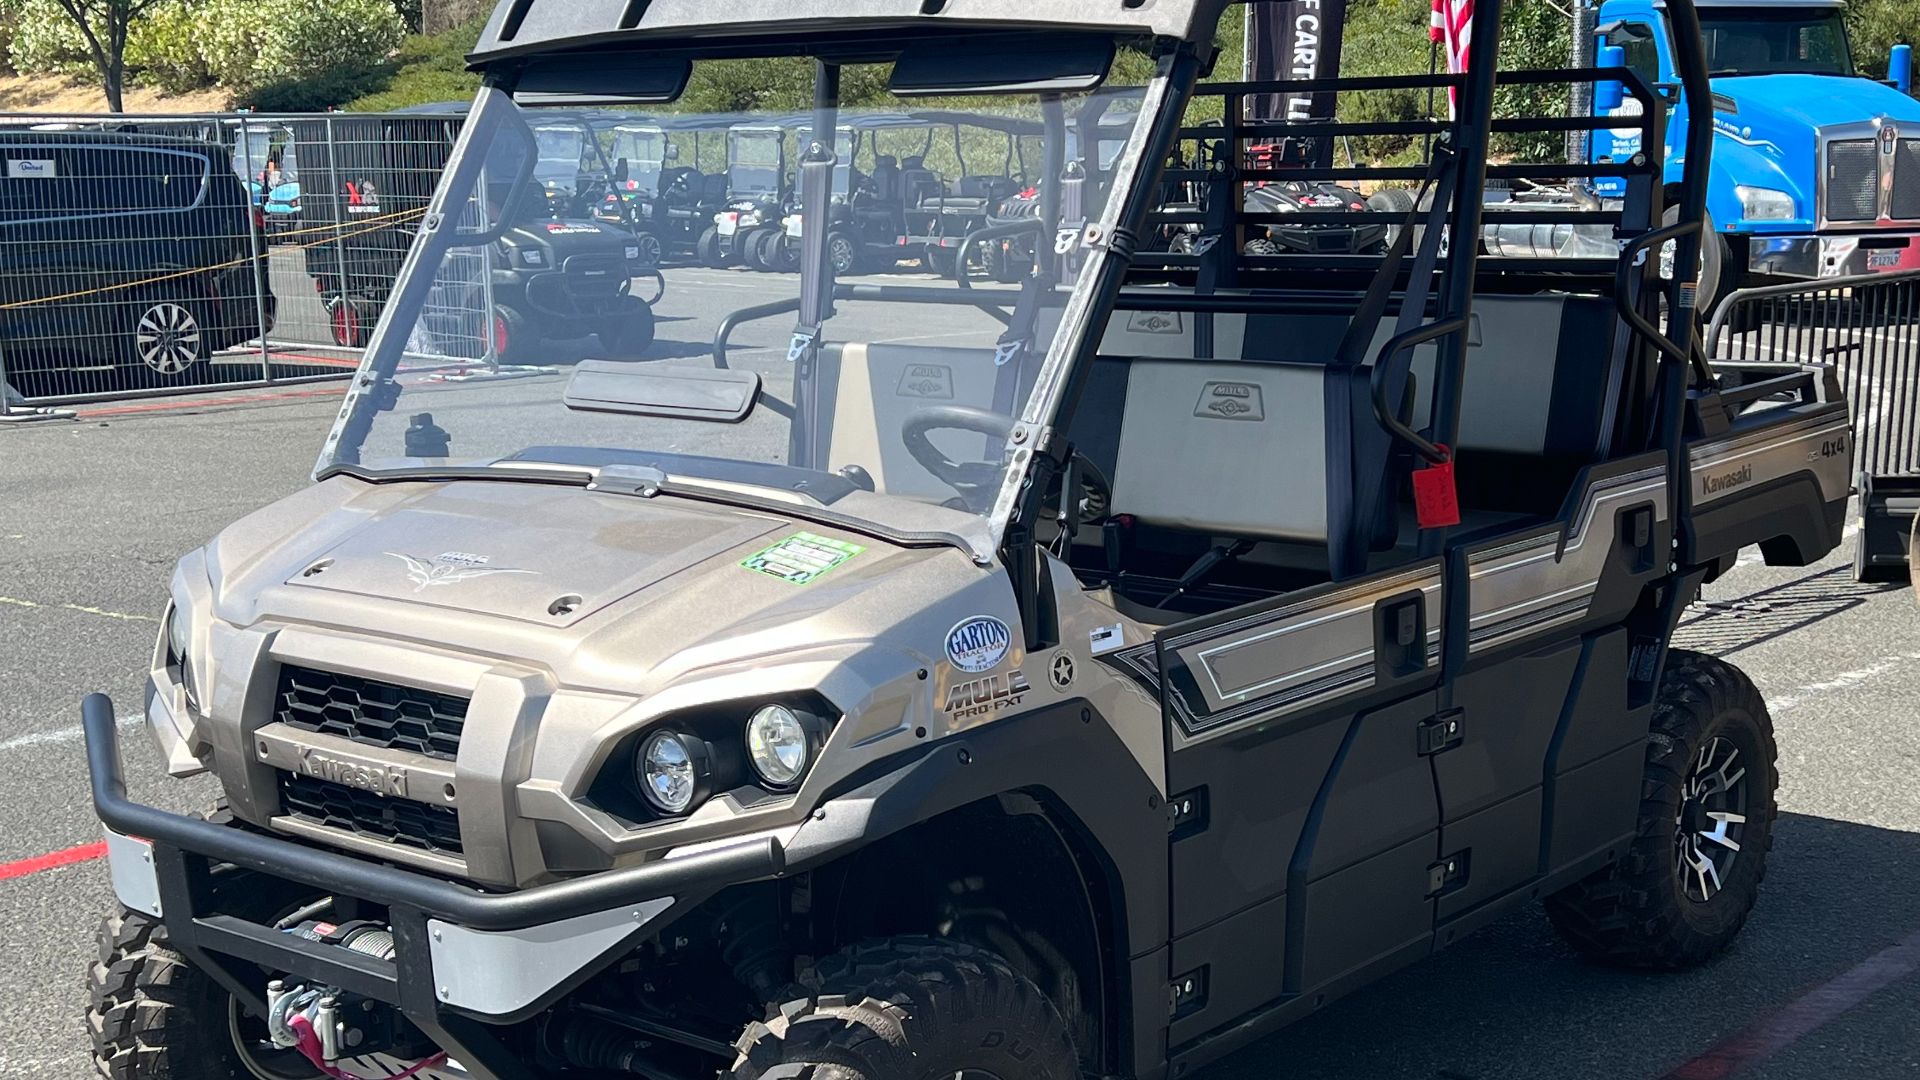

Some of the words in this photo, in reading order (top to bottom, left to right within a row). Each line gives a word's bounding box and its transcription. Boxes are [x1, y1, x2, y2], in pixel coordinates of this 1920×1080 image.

[1292, 14, 1319, 81] CART
[1821, 436, 1845, 458] 4x4
[1702, 463, 1752, 495] Kawasaki
[949, 620, 1006, 656] GARTON
[957, 641, 1005, 661] TRACTOR
[943, 668, 1032, 714] MULE
[295, 744, 410, 797] Kawasaki
